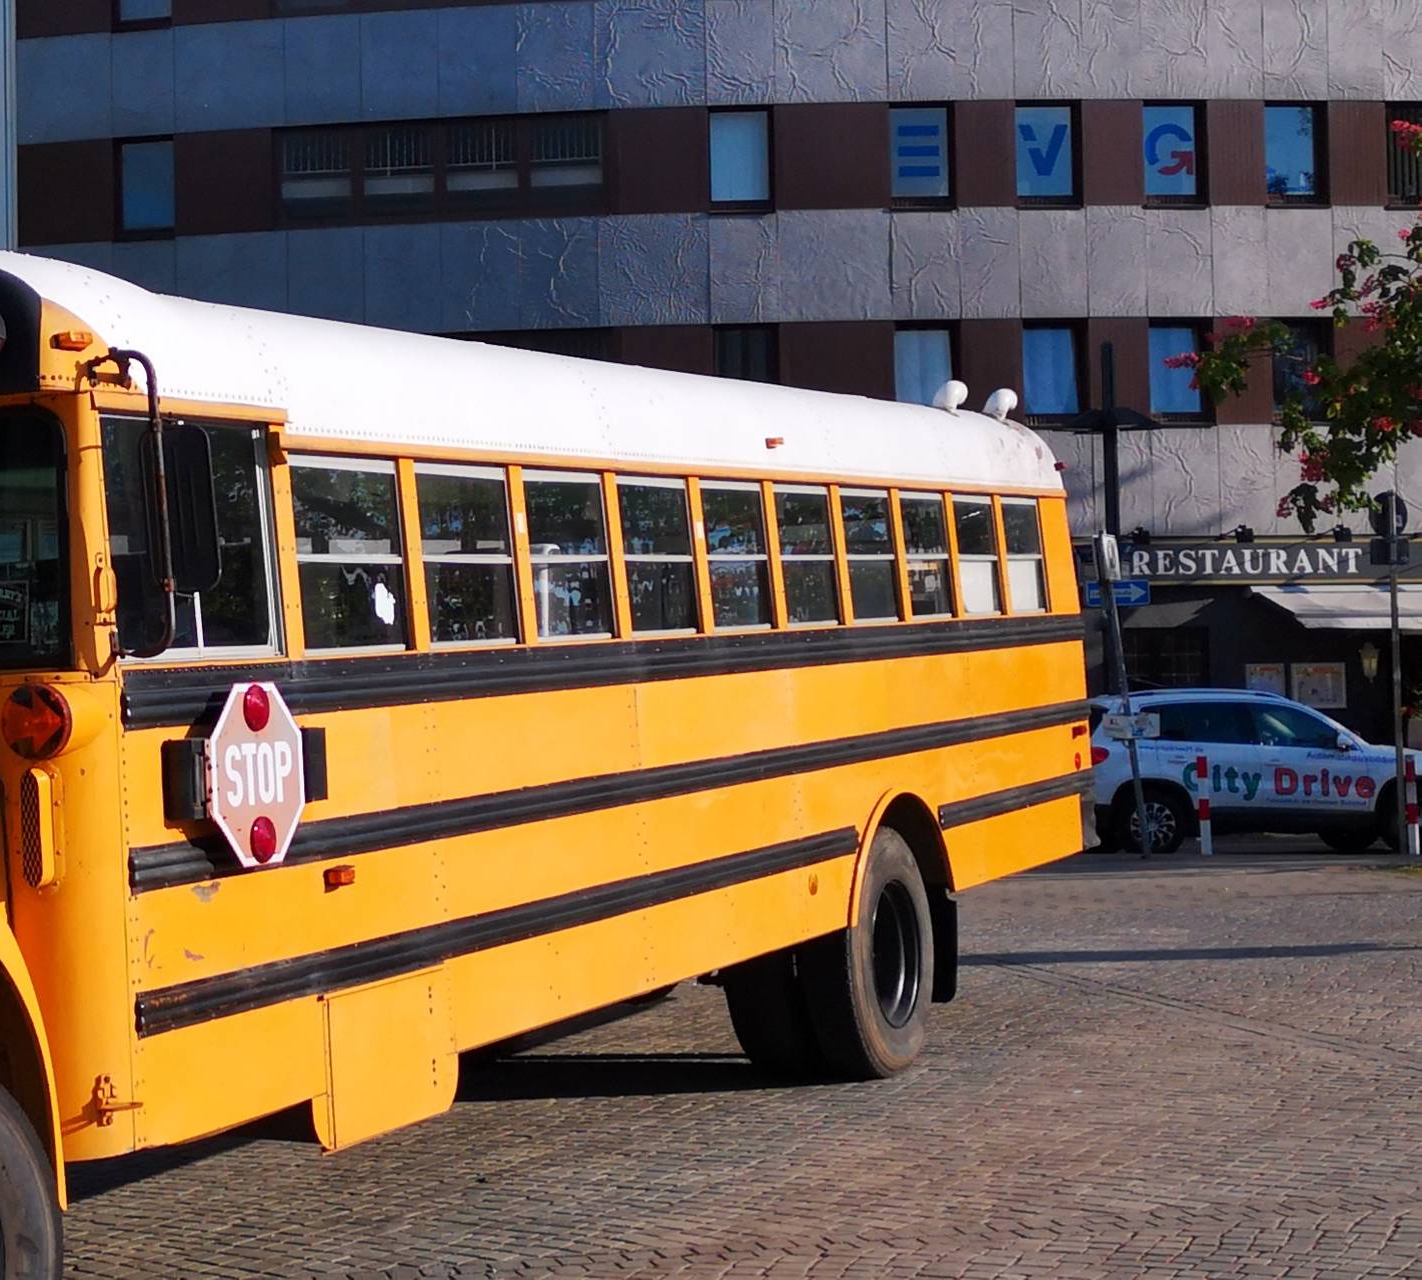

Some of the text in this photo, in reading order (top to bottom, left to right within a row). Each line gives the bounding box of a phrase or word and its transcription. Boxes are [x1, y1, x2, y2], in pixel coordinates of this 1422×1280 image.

[1131, 548, 1363, 576] RESTAURANT
[225, 741, 292, 807] STOP
[1182, 762, 1376, 801] City Drive
